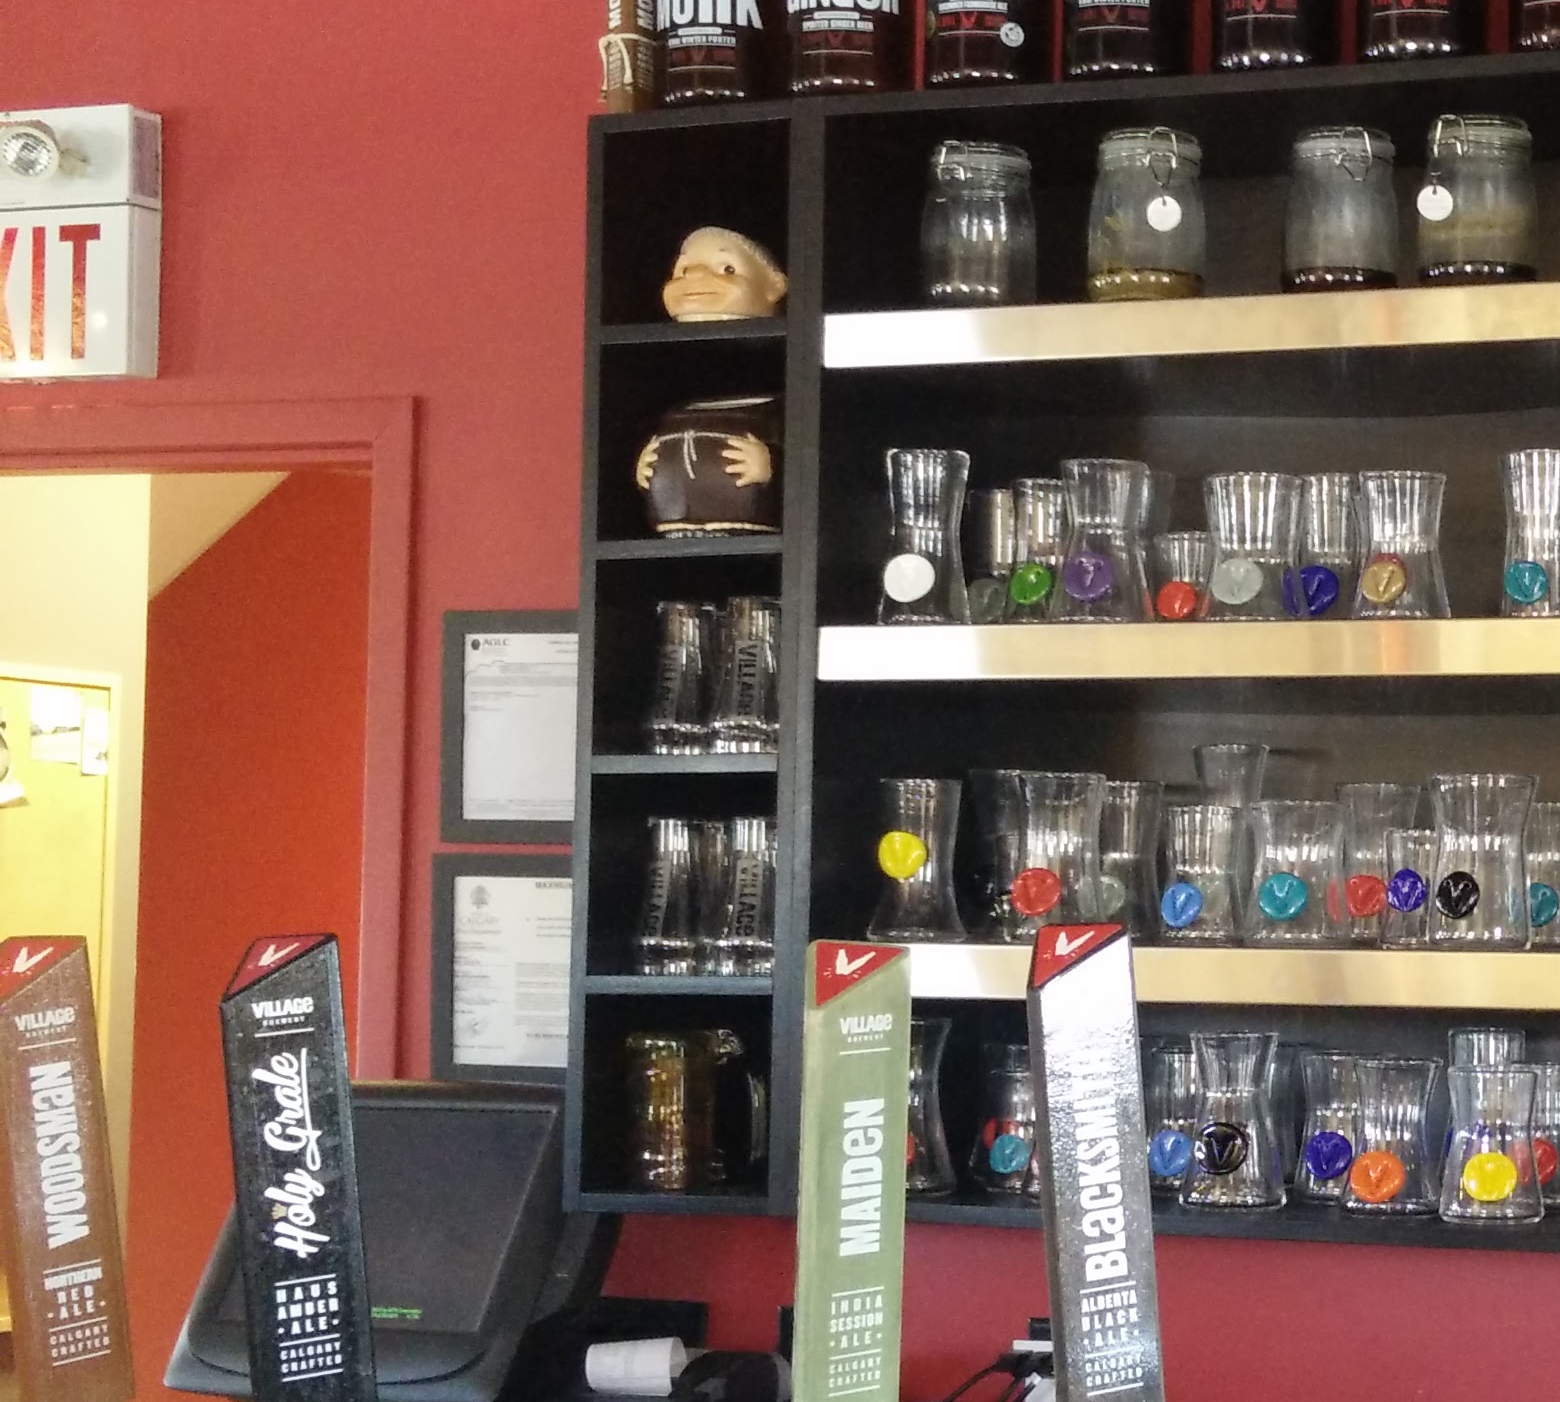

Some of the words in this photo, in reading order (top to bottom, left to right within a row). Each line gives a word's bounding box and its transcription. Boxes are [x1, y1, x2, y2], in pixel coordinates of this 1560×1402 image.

[252, 1048, 322, 1171] Grale
[264, 1168, 331, 1259] Holy
[57, 1285, 94, 1304] RED
[276, 1281, 337, 1303] HAUS
[1082, 1289, 1137, 1313] ALBERTA
[59, 1300, 95, 1319] ALE
[277, 1298, 339, 1320] AMBER
[831, 1295, 882, 1315] INDIA
[291, 1316, 328, 1335] ALE
[830, 1312, 883, 1333] SESSION
[1082, 1308, 1138, 1331] BLACK
[50, 1324, 108, 1345] CALGARY
[841, 1331, 872, 1348] ALE
[1095, 1327, 1128, 1347] ALE
[51, 1336, 110, 1357] CRAFTED
[280, 1342, 340, 1360] CALGARY
[281, 1354, 342, 1373] CRAFTED
[830, 1357, 881, 1374] CALGARY
[1086, 1353, 1141, 1373] CALGARY
[829, 1370, 881, 1387] CRAFTED
[1087, 1367, 1142, 1387] CRAFTED
